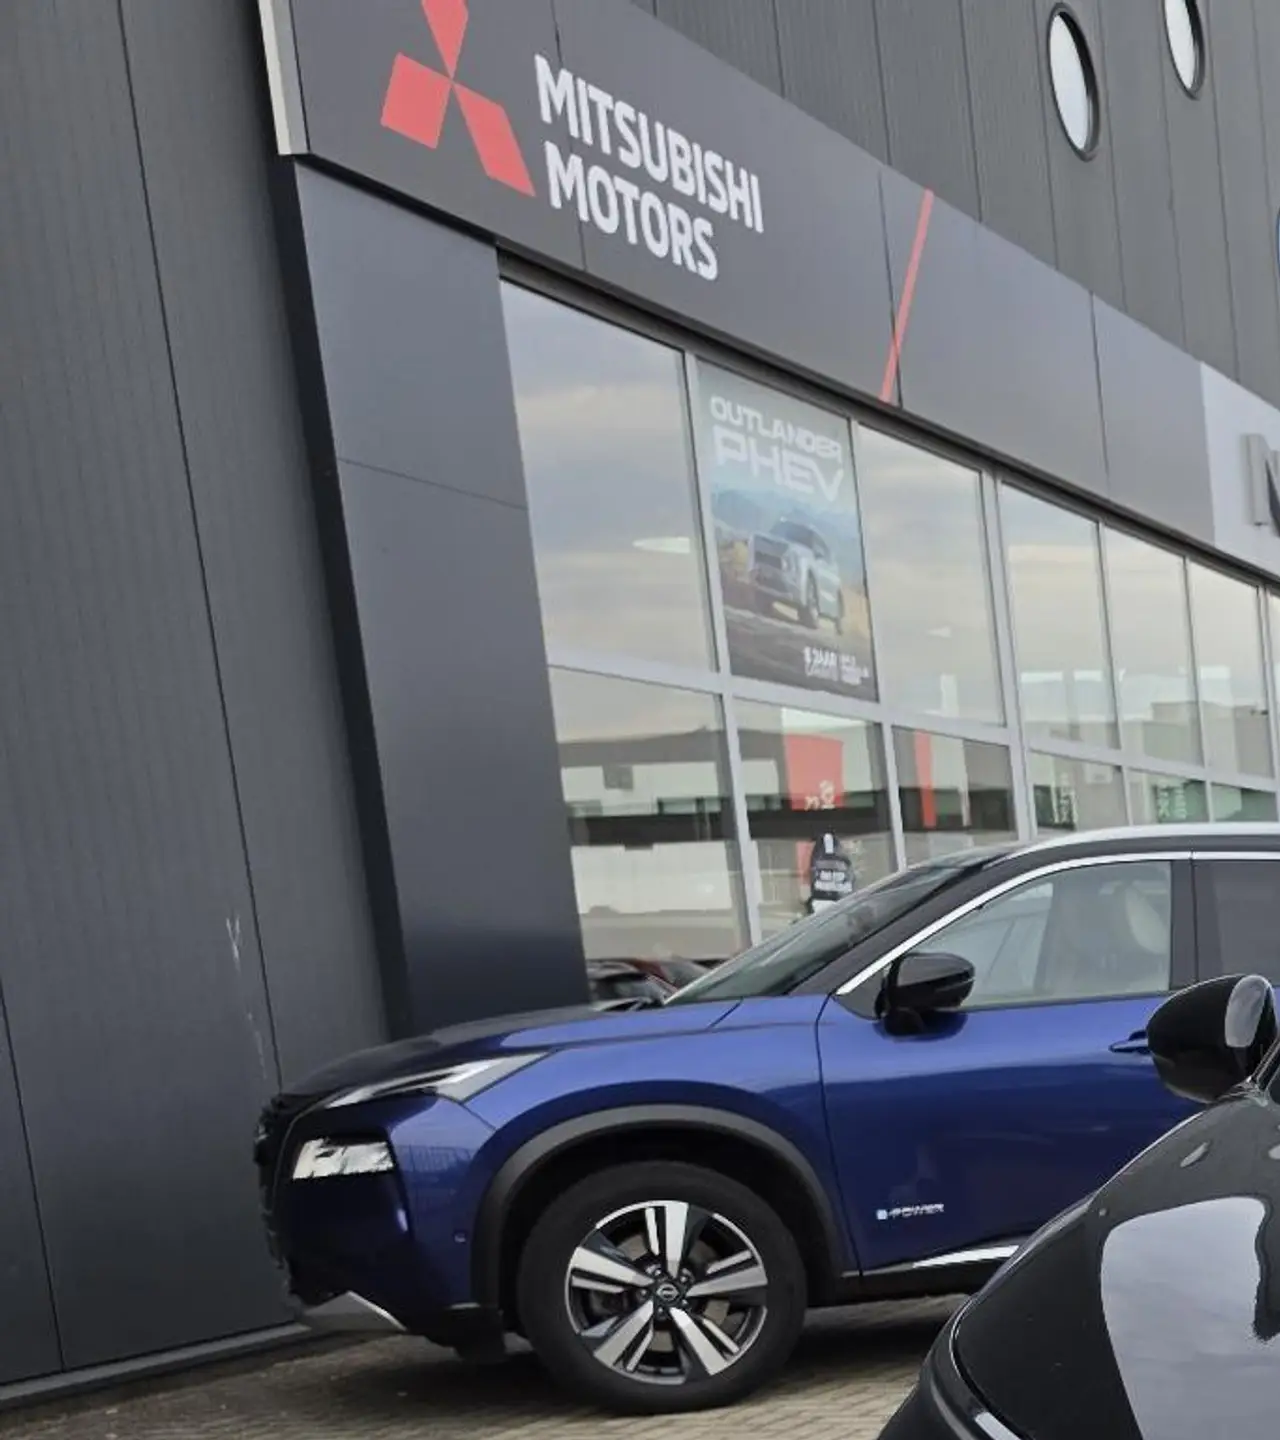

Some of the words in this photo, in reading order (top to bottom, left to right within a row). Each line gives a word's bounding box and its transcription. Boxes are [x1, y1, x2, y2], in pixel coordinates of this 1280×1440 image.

[534, 53, 764, 234] MITSUBISHI
[544, 140, 718, 281] MOTORS
[712, 424, 845, 502] PHEV
